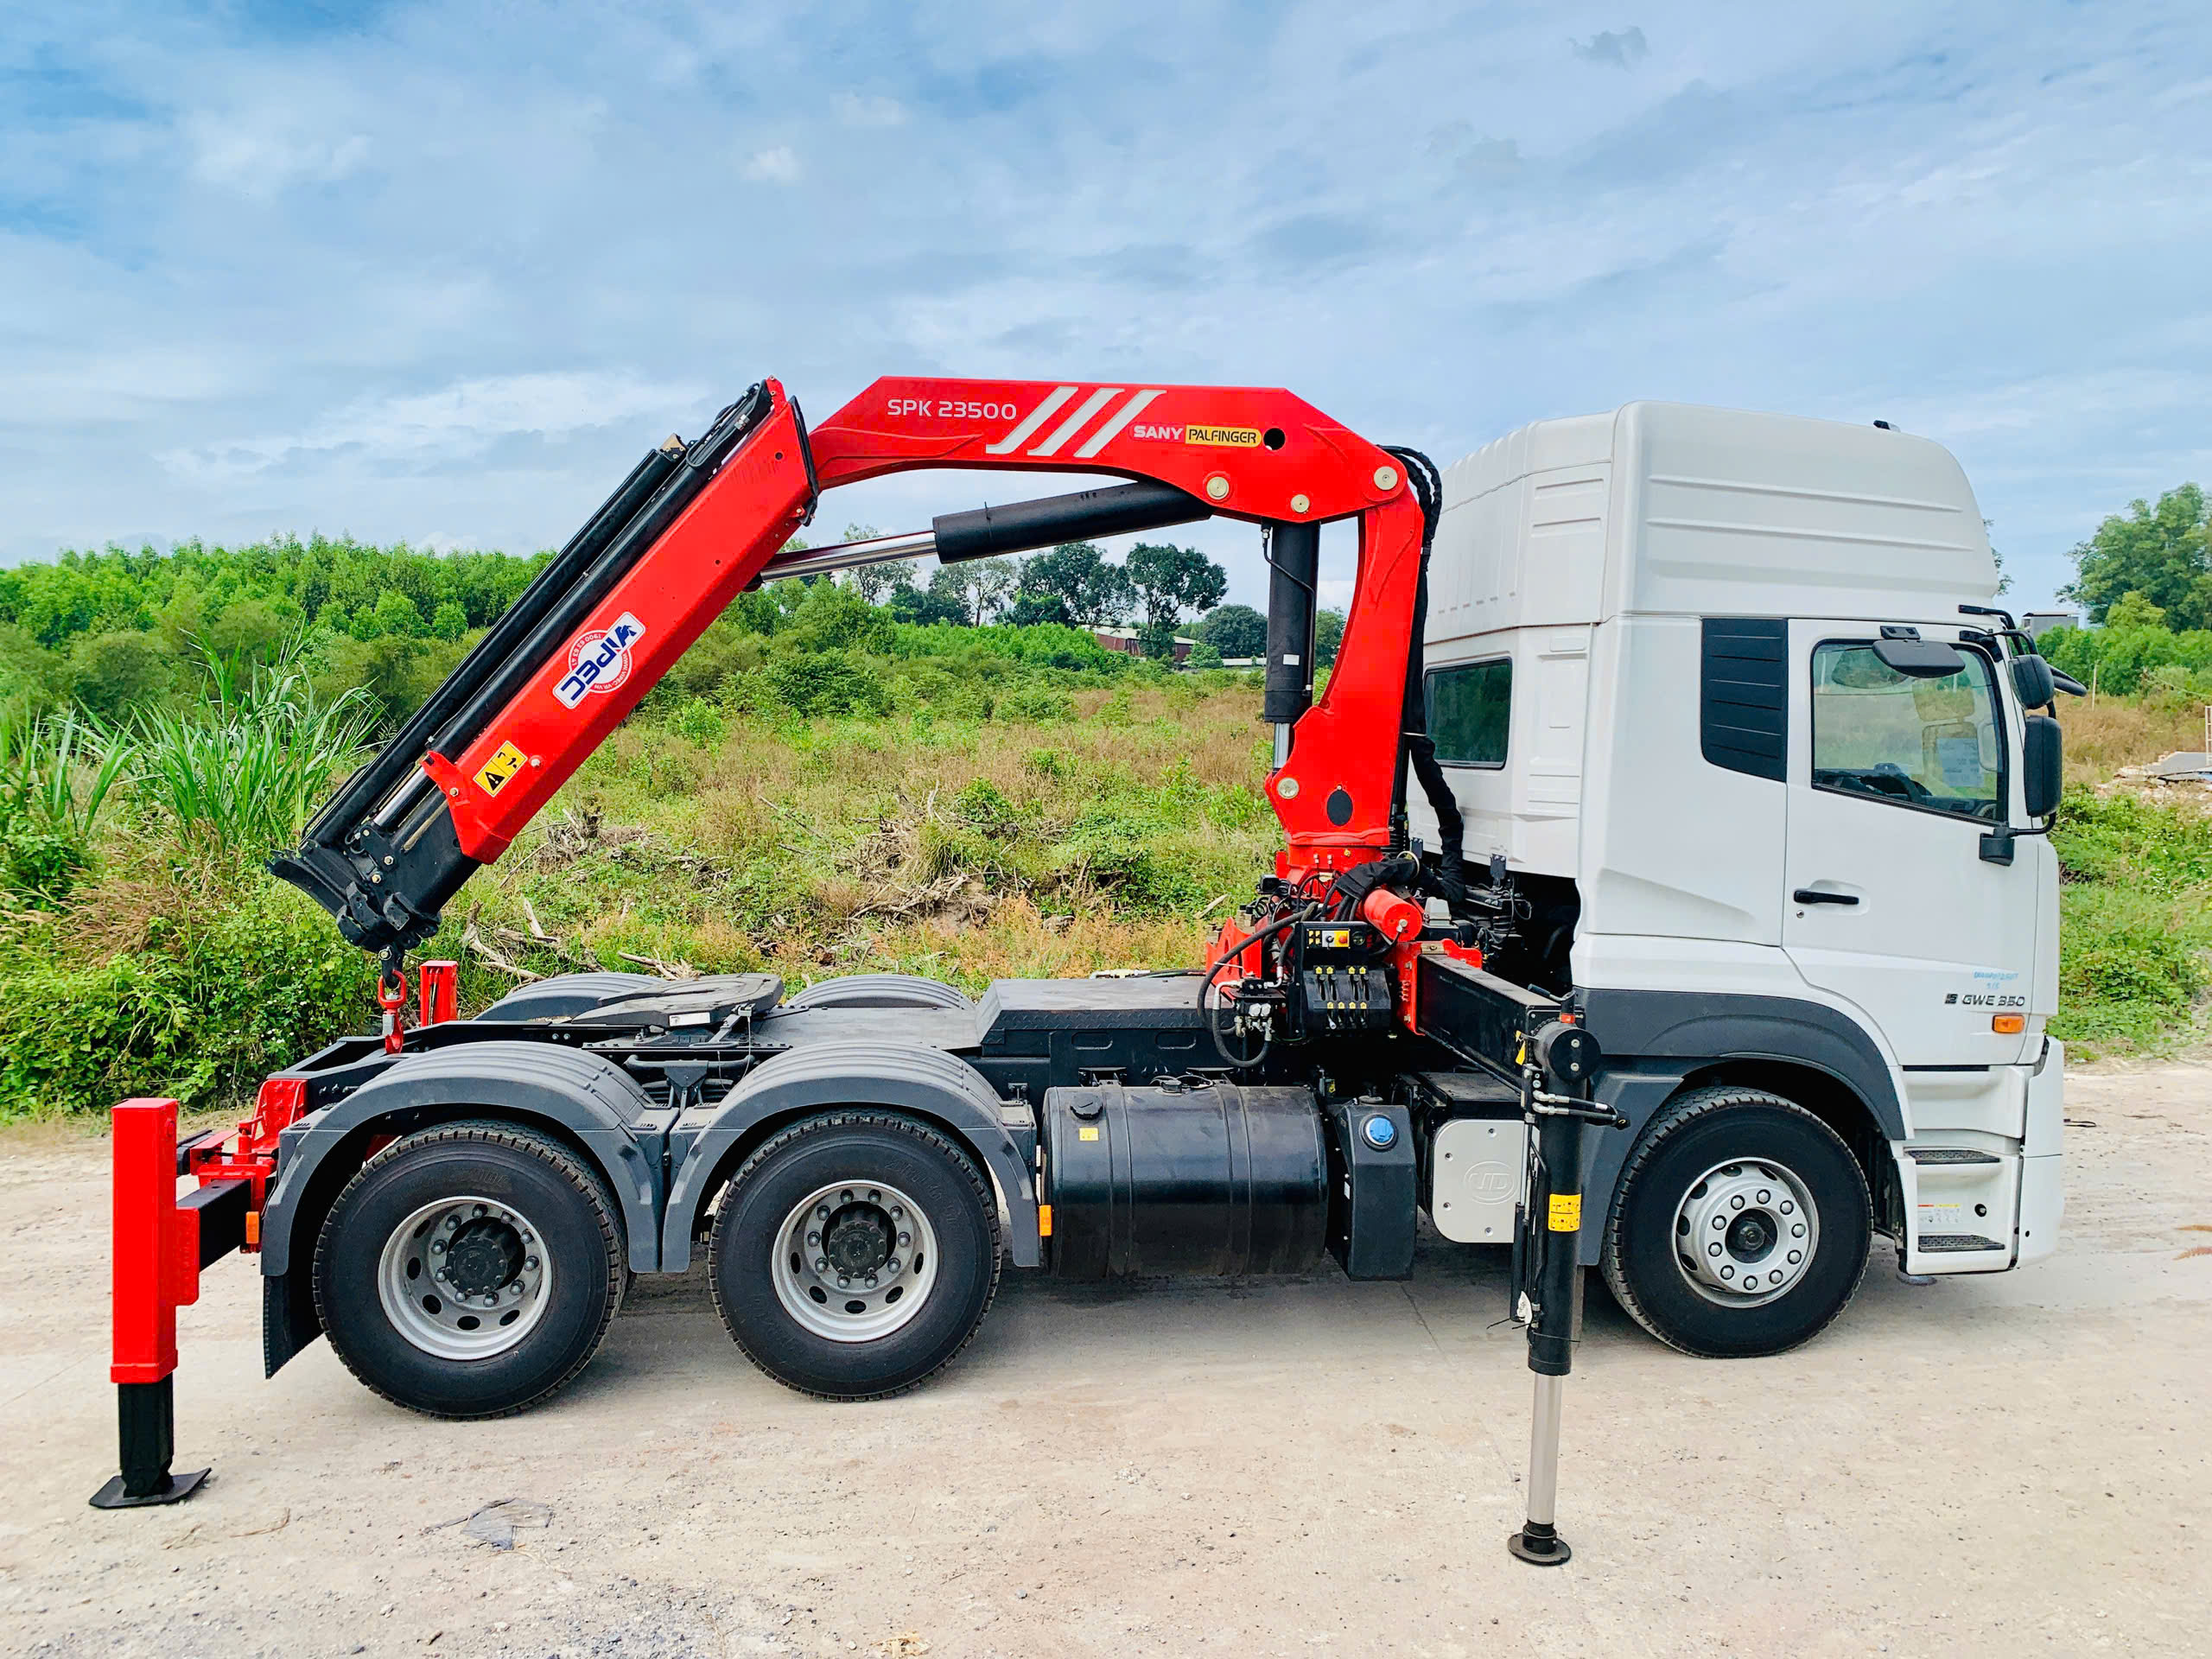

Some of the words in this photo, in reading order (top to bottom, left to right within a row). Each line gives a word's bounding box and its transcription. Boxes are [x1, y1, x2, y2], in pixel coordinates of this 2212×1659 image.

[887, 398, 932, 416] SPK
[938, 400, 1017, 420] 23500
[1133, 425, 1184, 441] SANY
[1187, 429, 1258, 444] PALFINGER
[584, 632, 602, 642] 1900
[560, 625, 637, 702] VIPEC
[1961, 995, 1996, 1006] GWE
[1997, 995, 2025, 1007] 350
